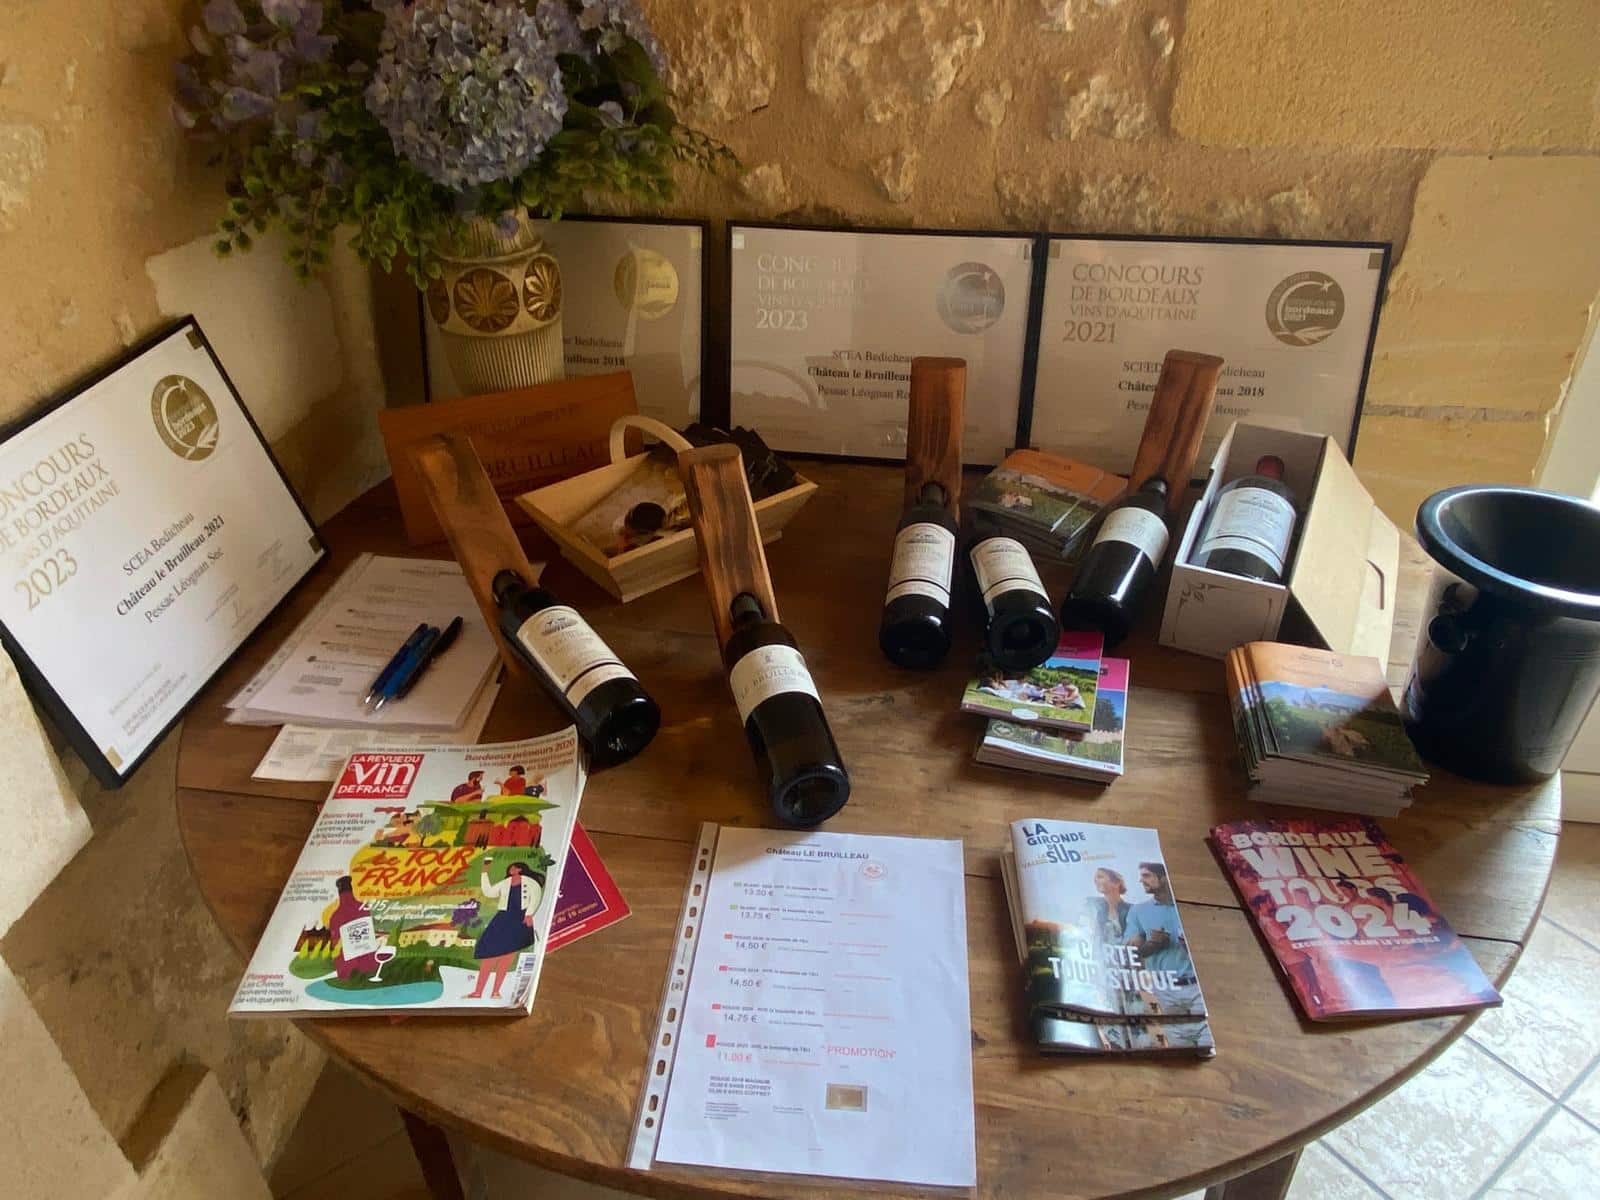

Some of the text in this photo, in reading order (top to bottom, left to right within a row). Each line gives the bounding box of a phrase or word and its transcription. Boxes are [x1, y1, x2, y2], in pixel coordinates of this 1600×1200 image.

[1072, 263, 1205, 286] CONCOURS
[1071, 285, 1200, 305] DE BORDEAUX
[756, 308, 809, 330] 2023
[1069, 303, 1199, 321] VINS D'AQUITAINE
[1062, 319, 1117, 344] 2021
[807, 366, 850, 379] Château
[1236, 385, 1266, 397] 2018
[0, 432, 96, 521] ONCOURS
[15, 458, 110, 537] BORDEAUX
[122, 512, 195, 576] SCEA Bedicheau
[116, 514, 226, 616] Château le Bruilleau 2021
[14, 547, 79, 611] 2023
[144, 592, 175, 624] Pessac
[172, 561, 210, 597] Léognan
[352, 755, 421, 764] LA REVUE DU
[350, 763, 417, 787] vin
[340, 784, 408, 794] DE FRANCE
[1022, 823, 1049, 838] LA
[1026, 832, 1087, 846] GIRONDE
[1231, 830, 1371, 850] BORDEAUX
[404, 846, 477, 869] TOUR
[766, 847, 870, 860] Château LE BRUILLEAU
[1046, 844, 1082, 864] SUD
[1238, 845, 1394, 879] WINE
[357, 864, 470, 889] FRANCE
[1275, 900, 1435, 942] 2024
[1047, 956, 1184, 994] TOURSTIQUE
